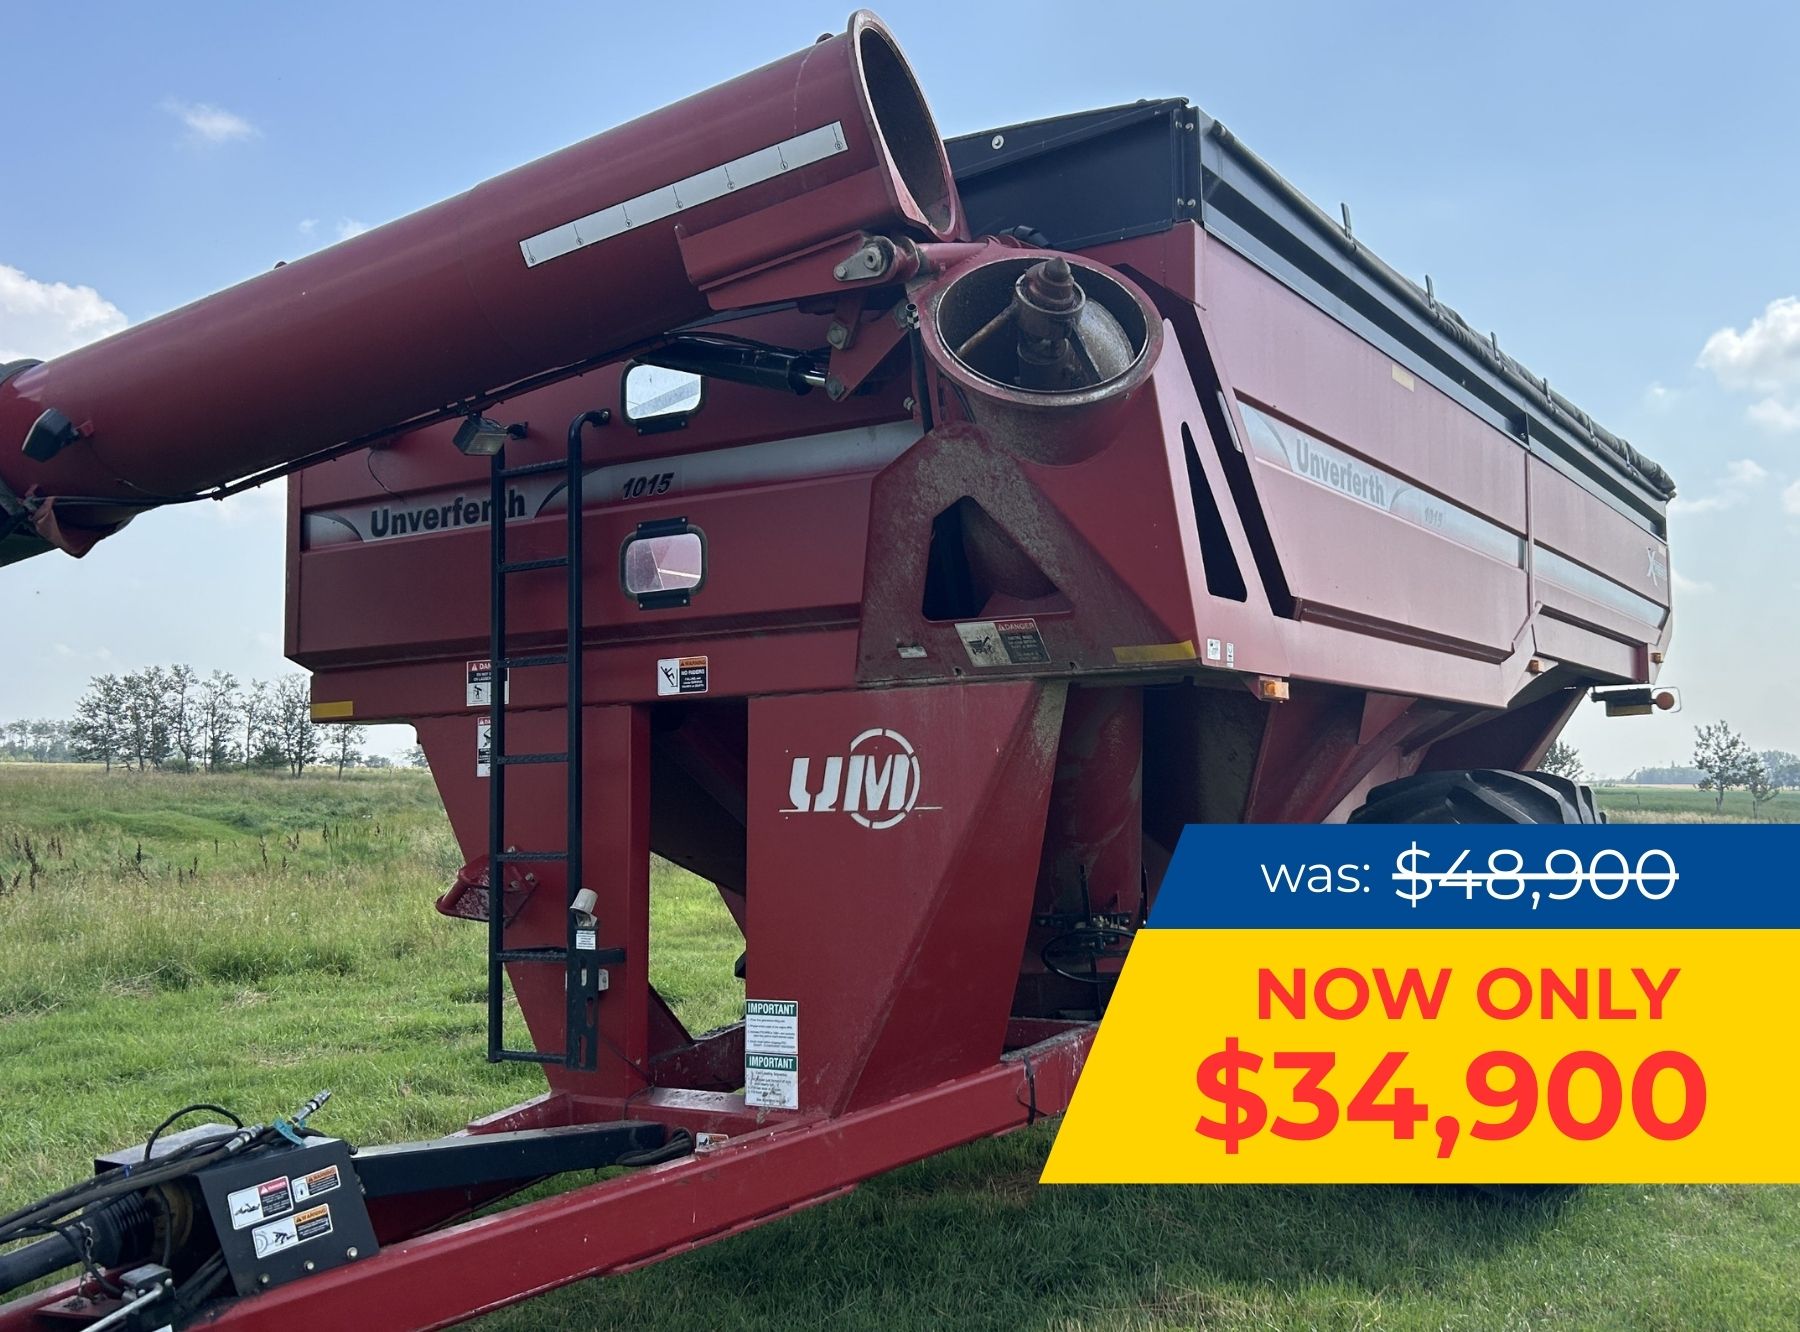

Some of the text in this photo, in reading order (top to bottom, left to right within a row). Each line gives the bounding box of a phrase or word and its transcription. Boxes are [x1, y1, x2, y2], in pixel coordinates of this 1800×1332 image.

[622, 472, 675, 499] 1015
[1296, 439, 1387, 506] Unverferth
[371, 488, 525, 538] Unverferh
[1004, 622, 1035, 631] DANGER
[789, 754, 910, 812] UM
[747, 1003, 795, 1015] IMPORTANT
[749, 1056, 793, 1069] IMPORTANT
